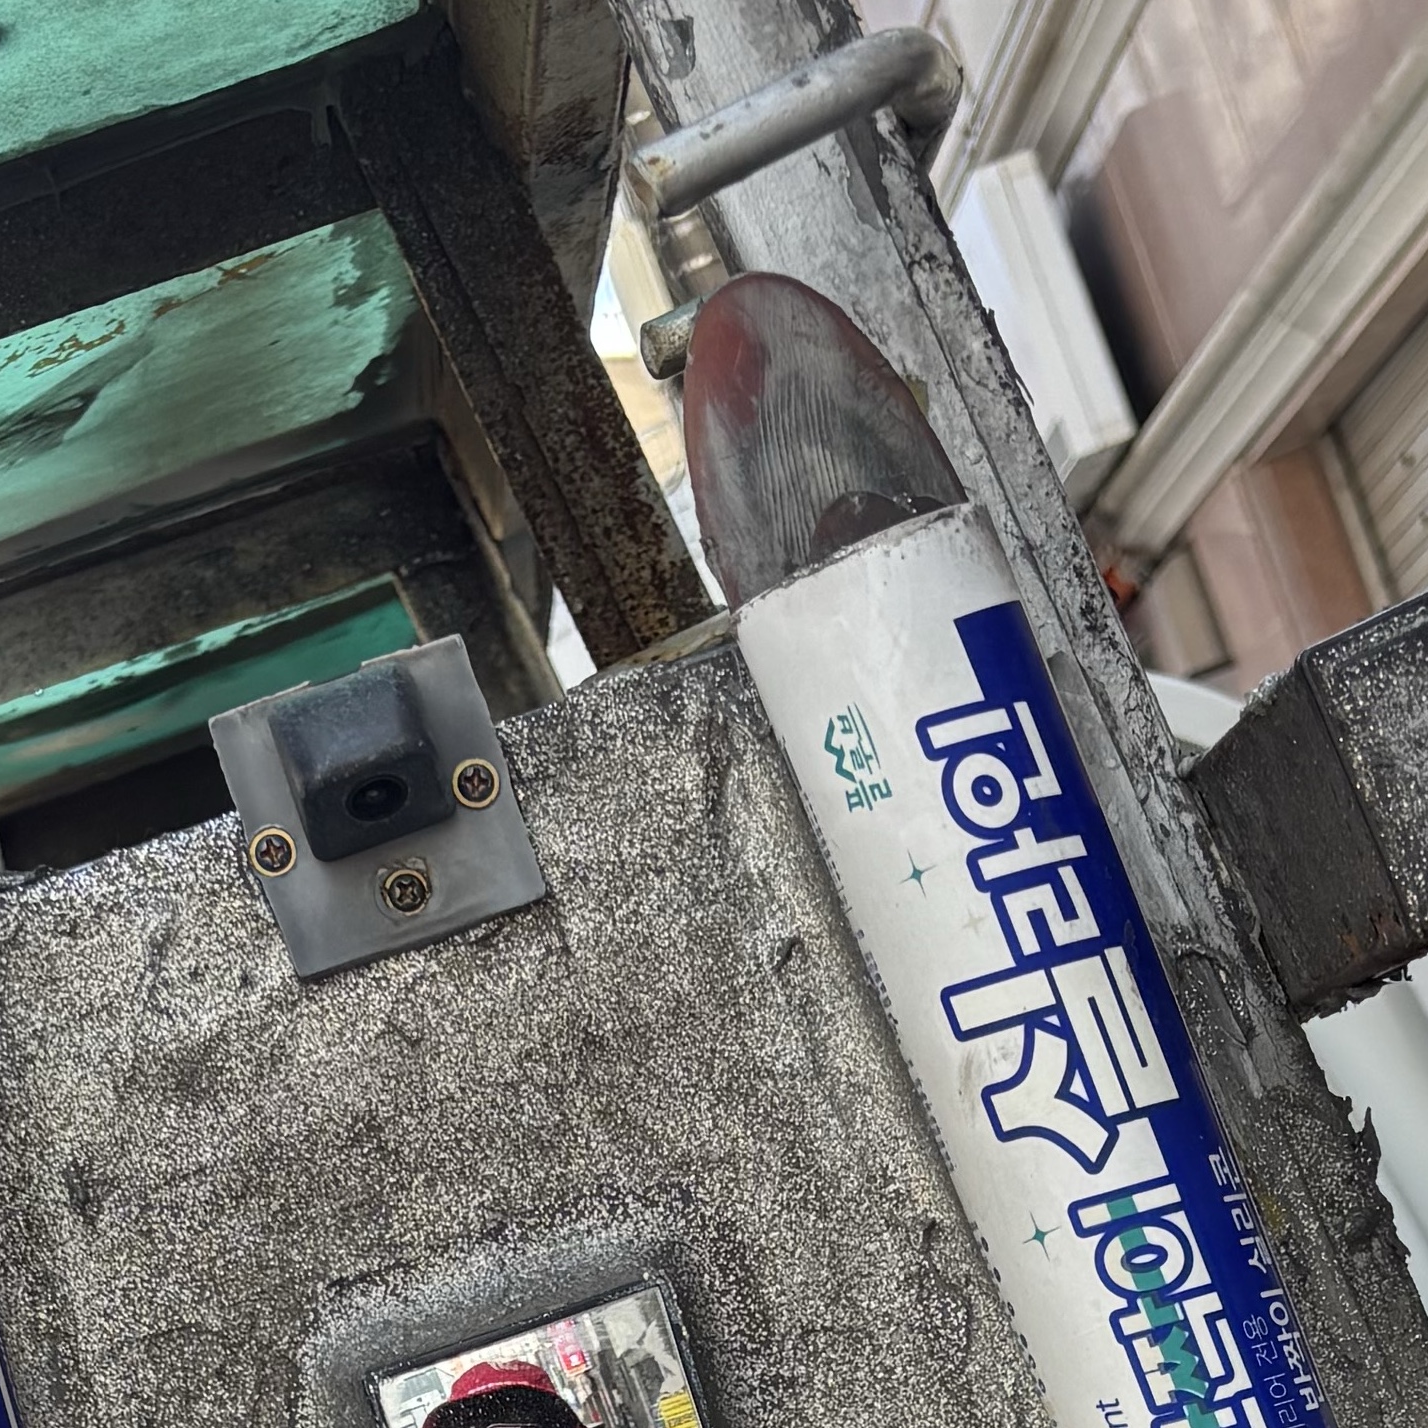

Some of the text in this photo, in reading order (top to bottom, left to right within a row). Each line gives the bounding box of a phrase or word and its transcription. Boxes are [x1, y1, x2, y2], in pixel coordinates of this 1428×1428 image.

[912, 693, 1187, 1168] 실라인
[1204, 1142, 1328, 1412] 반짝이 실리콘
[1240, 1310, 1279, 1368] 전용
